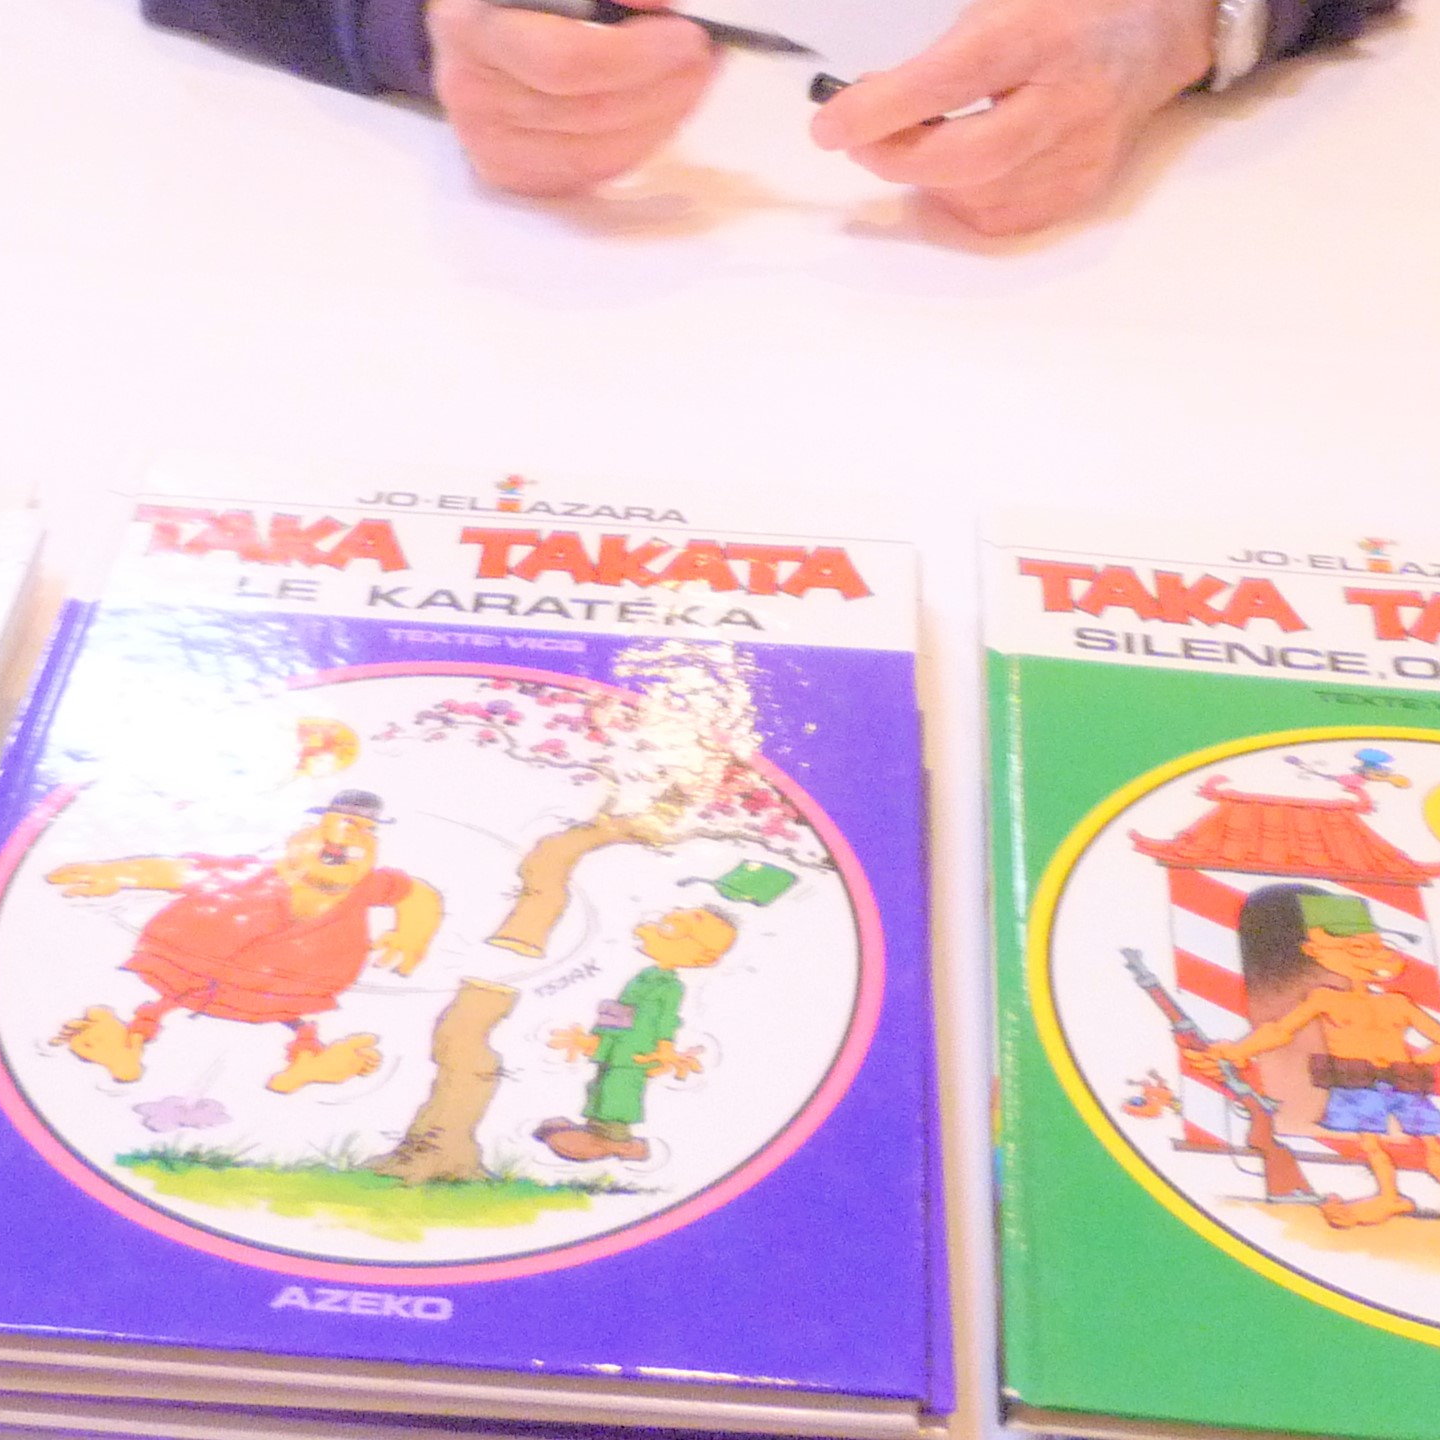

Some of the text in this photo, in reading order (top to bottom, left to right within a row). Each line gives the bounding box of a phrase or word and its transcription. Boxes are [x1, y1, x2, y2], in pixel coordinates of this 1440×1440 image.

[524, 500, 689, 524] AZARA
[133, 504, 876, 600] TAKA TAKATA
[234, 576, 766, 631] LE KARATÉKA
[1018, 557, 1312, 633] TAKA
[269, 1285, 454, 1321] AZEKO
